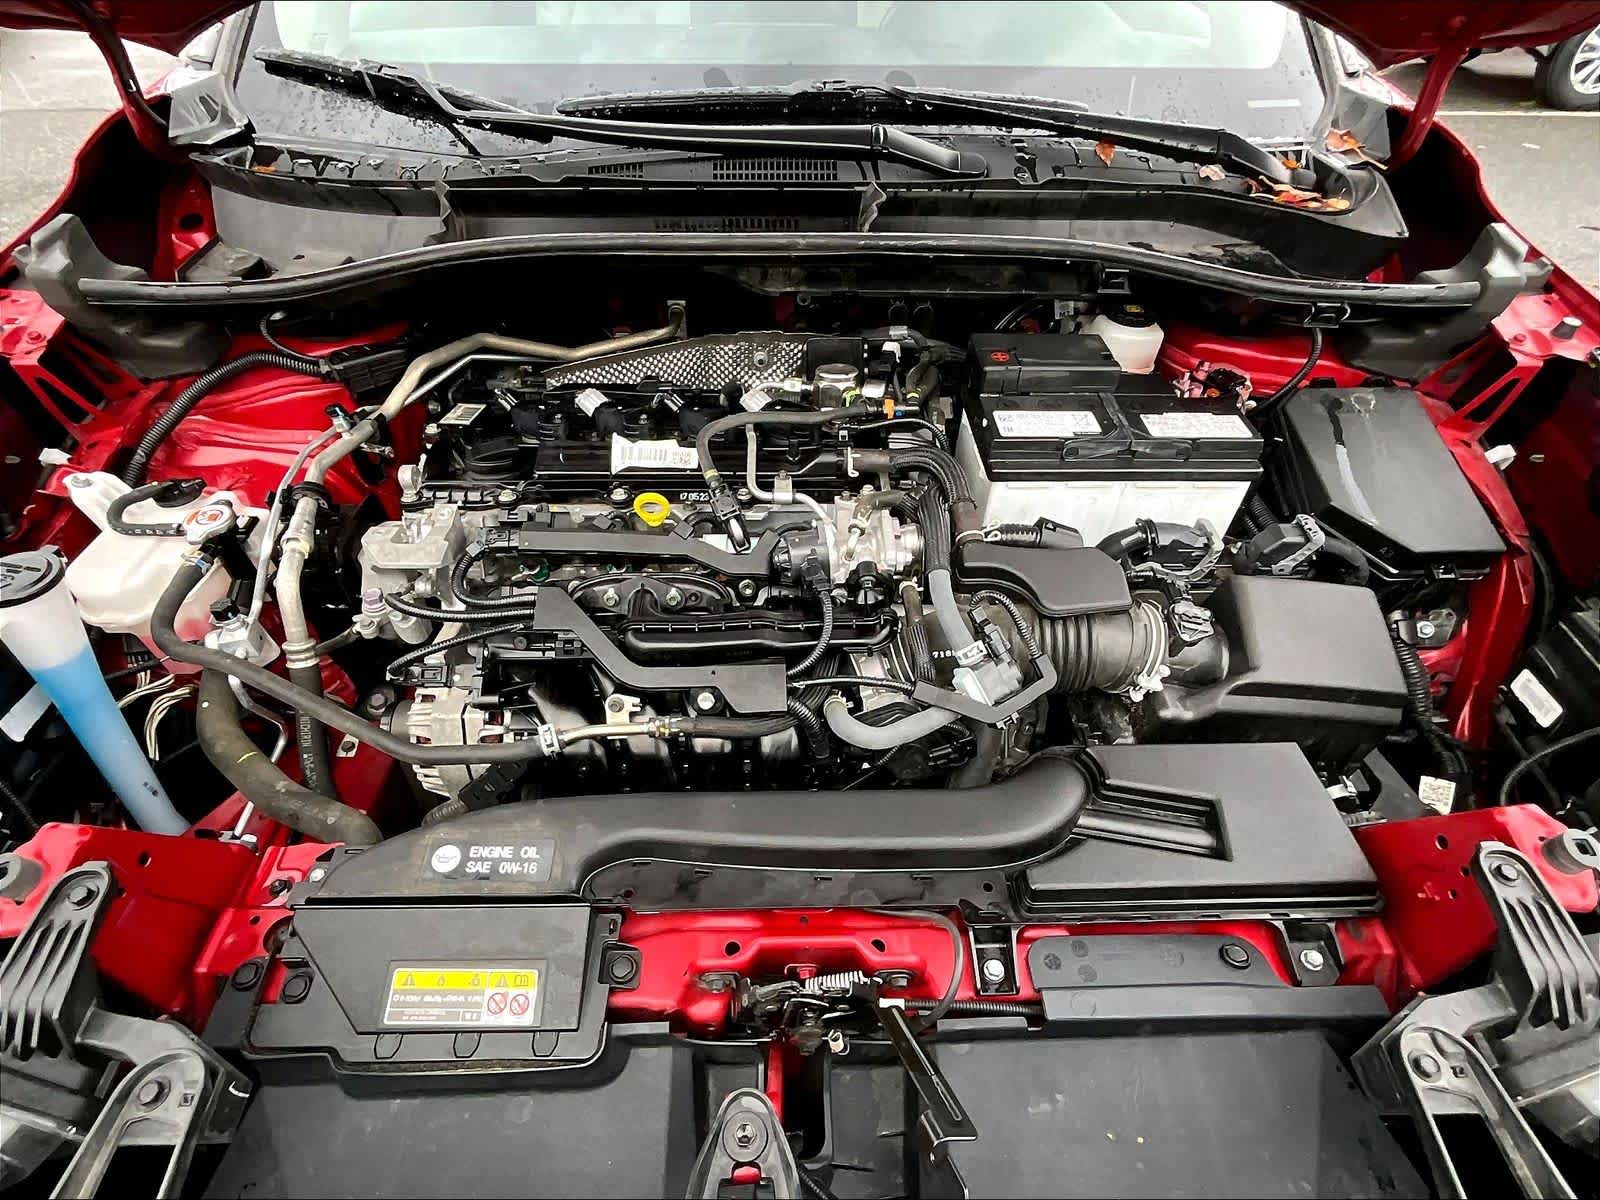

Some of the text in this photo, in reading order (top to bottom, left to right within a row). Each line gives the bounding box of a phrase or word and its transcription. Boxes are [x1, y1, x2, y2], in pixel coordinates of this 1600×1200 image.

[469, 845, 540, 859] ENGINE OIL
[464, 861, 538, 874] SAE 0W-16
